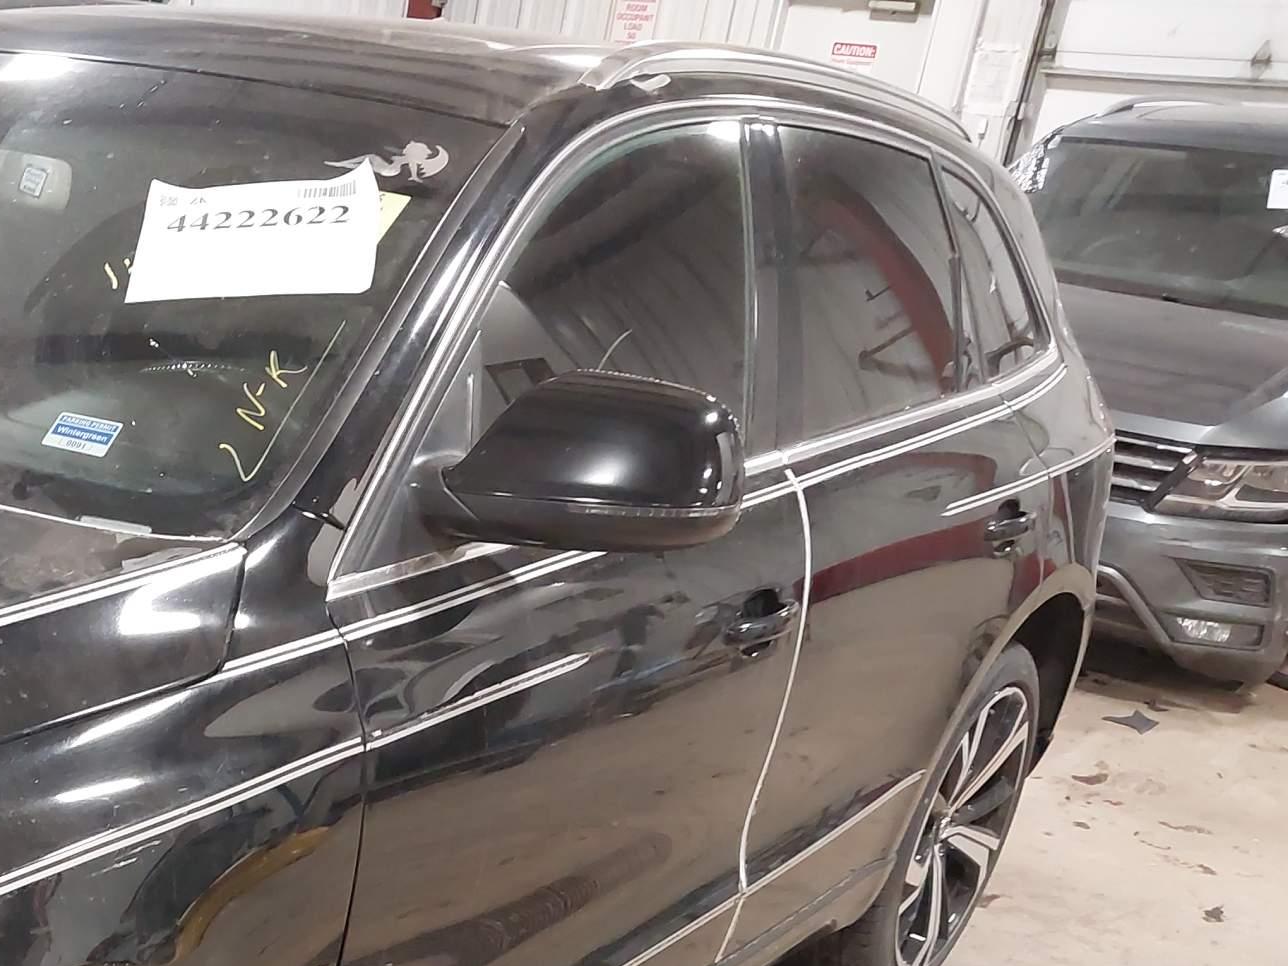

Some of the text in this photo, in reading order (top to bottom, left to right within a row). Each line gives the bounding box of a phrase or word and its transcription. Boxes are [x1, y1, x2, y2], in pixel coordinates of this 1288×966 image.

[833, 43, 876, 57] CAUTION:
[167, 205, 349, 232] 44222622
[62, 415, 91, 428] PARKING
[56, 424, 108, 443] Wintergreen
